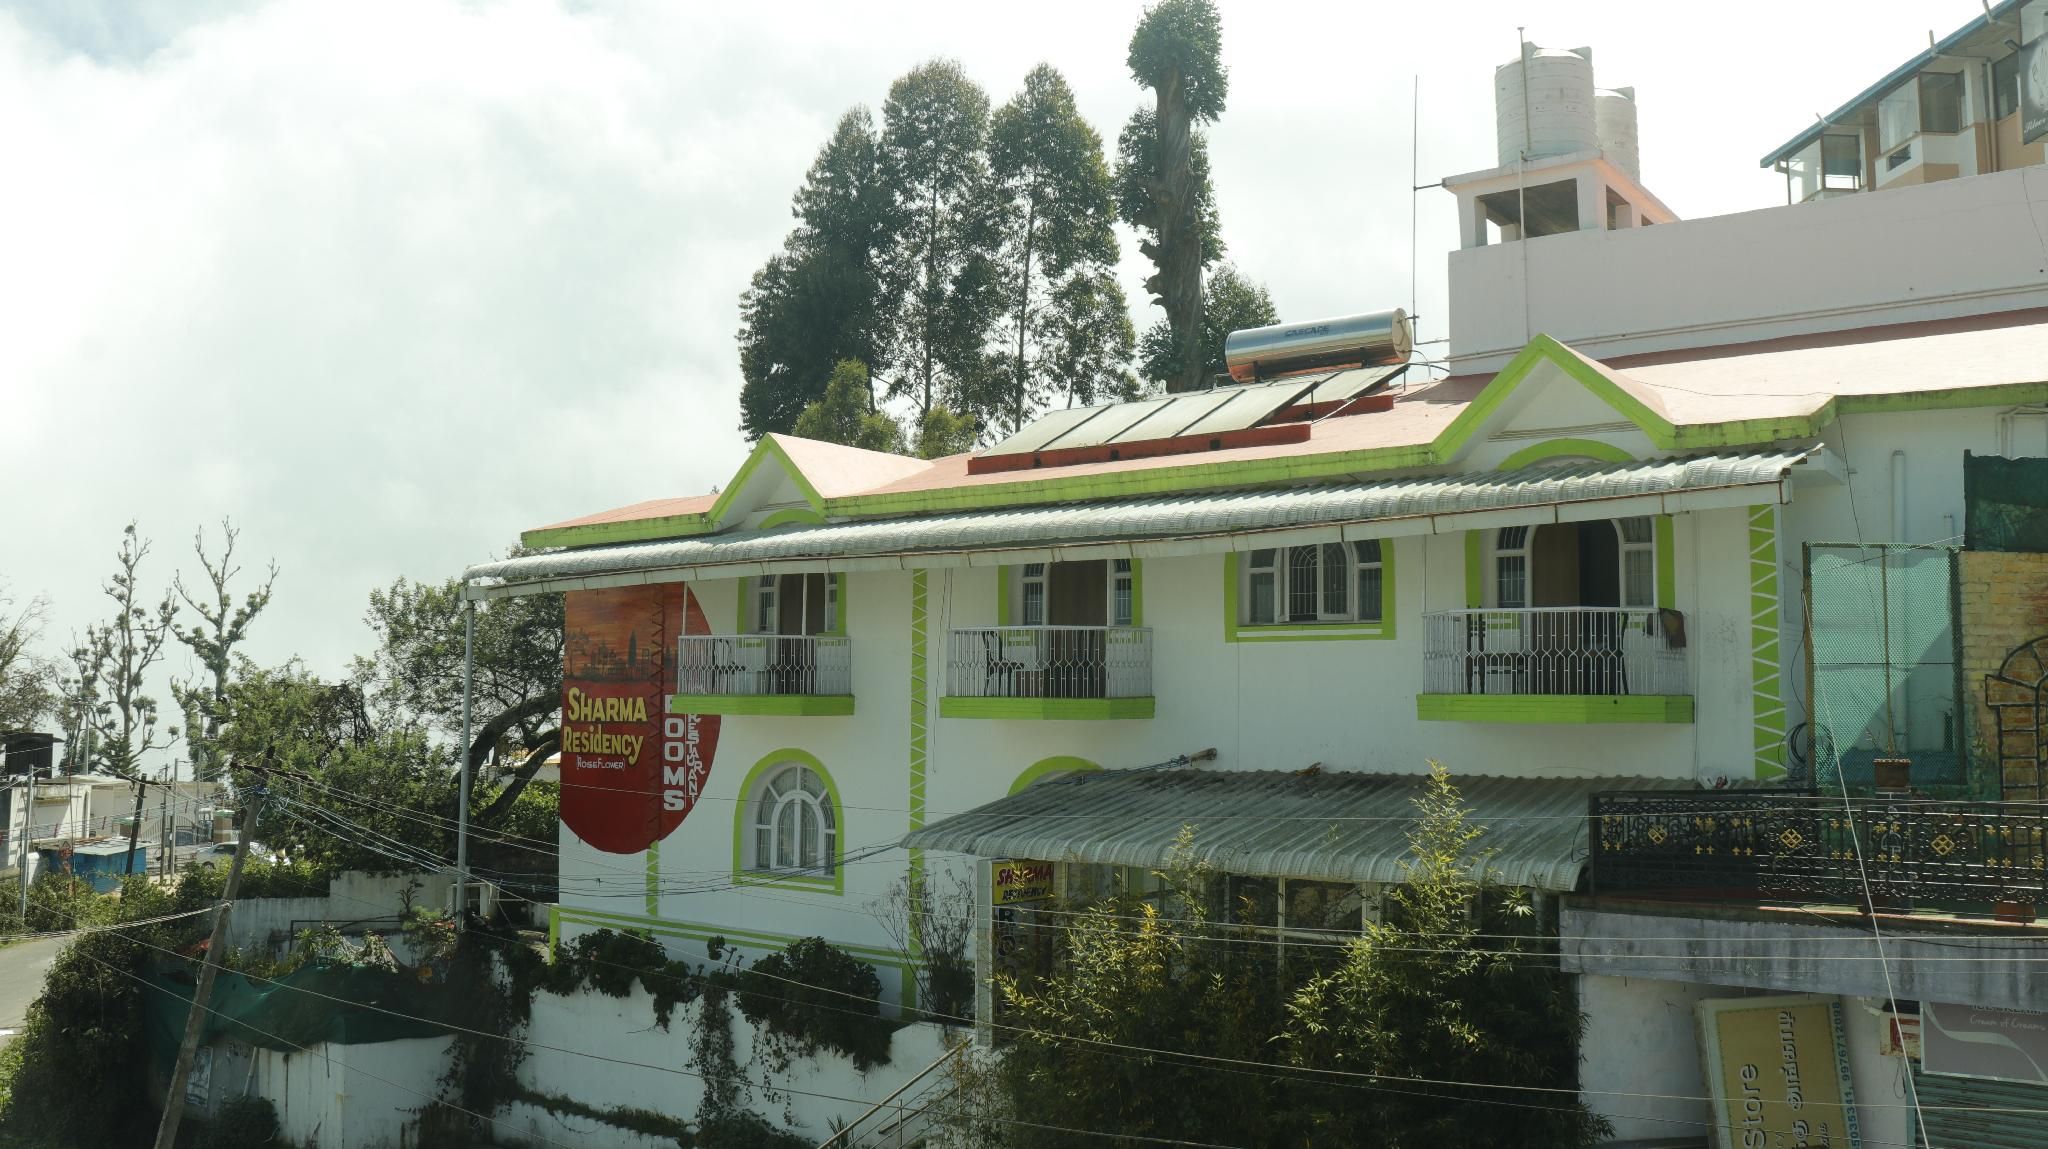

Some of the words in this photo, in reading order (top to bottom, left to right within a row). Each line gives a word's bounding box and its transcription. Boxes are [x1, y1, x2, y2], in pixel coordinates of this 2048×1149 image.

[568, 687, 648, 722] SHARMA
[1741, 1064, 1767, 1149] Store
[1844, 1086, 1861, 1149] 5035341,
